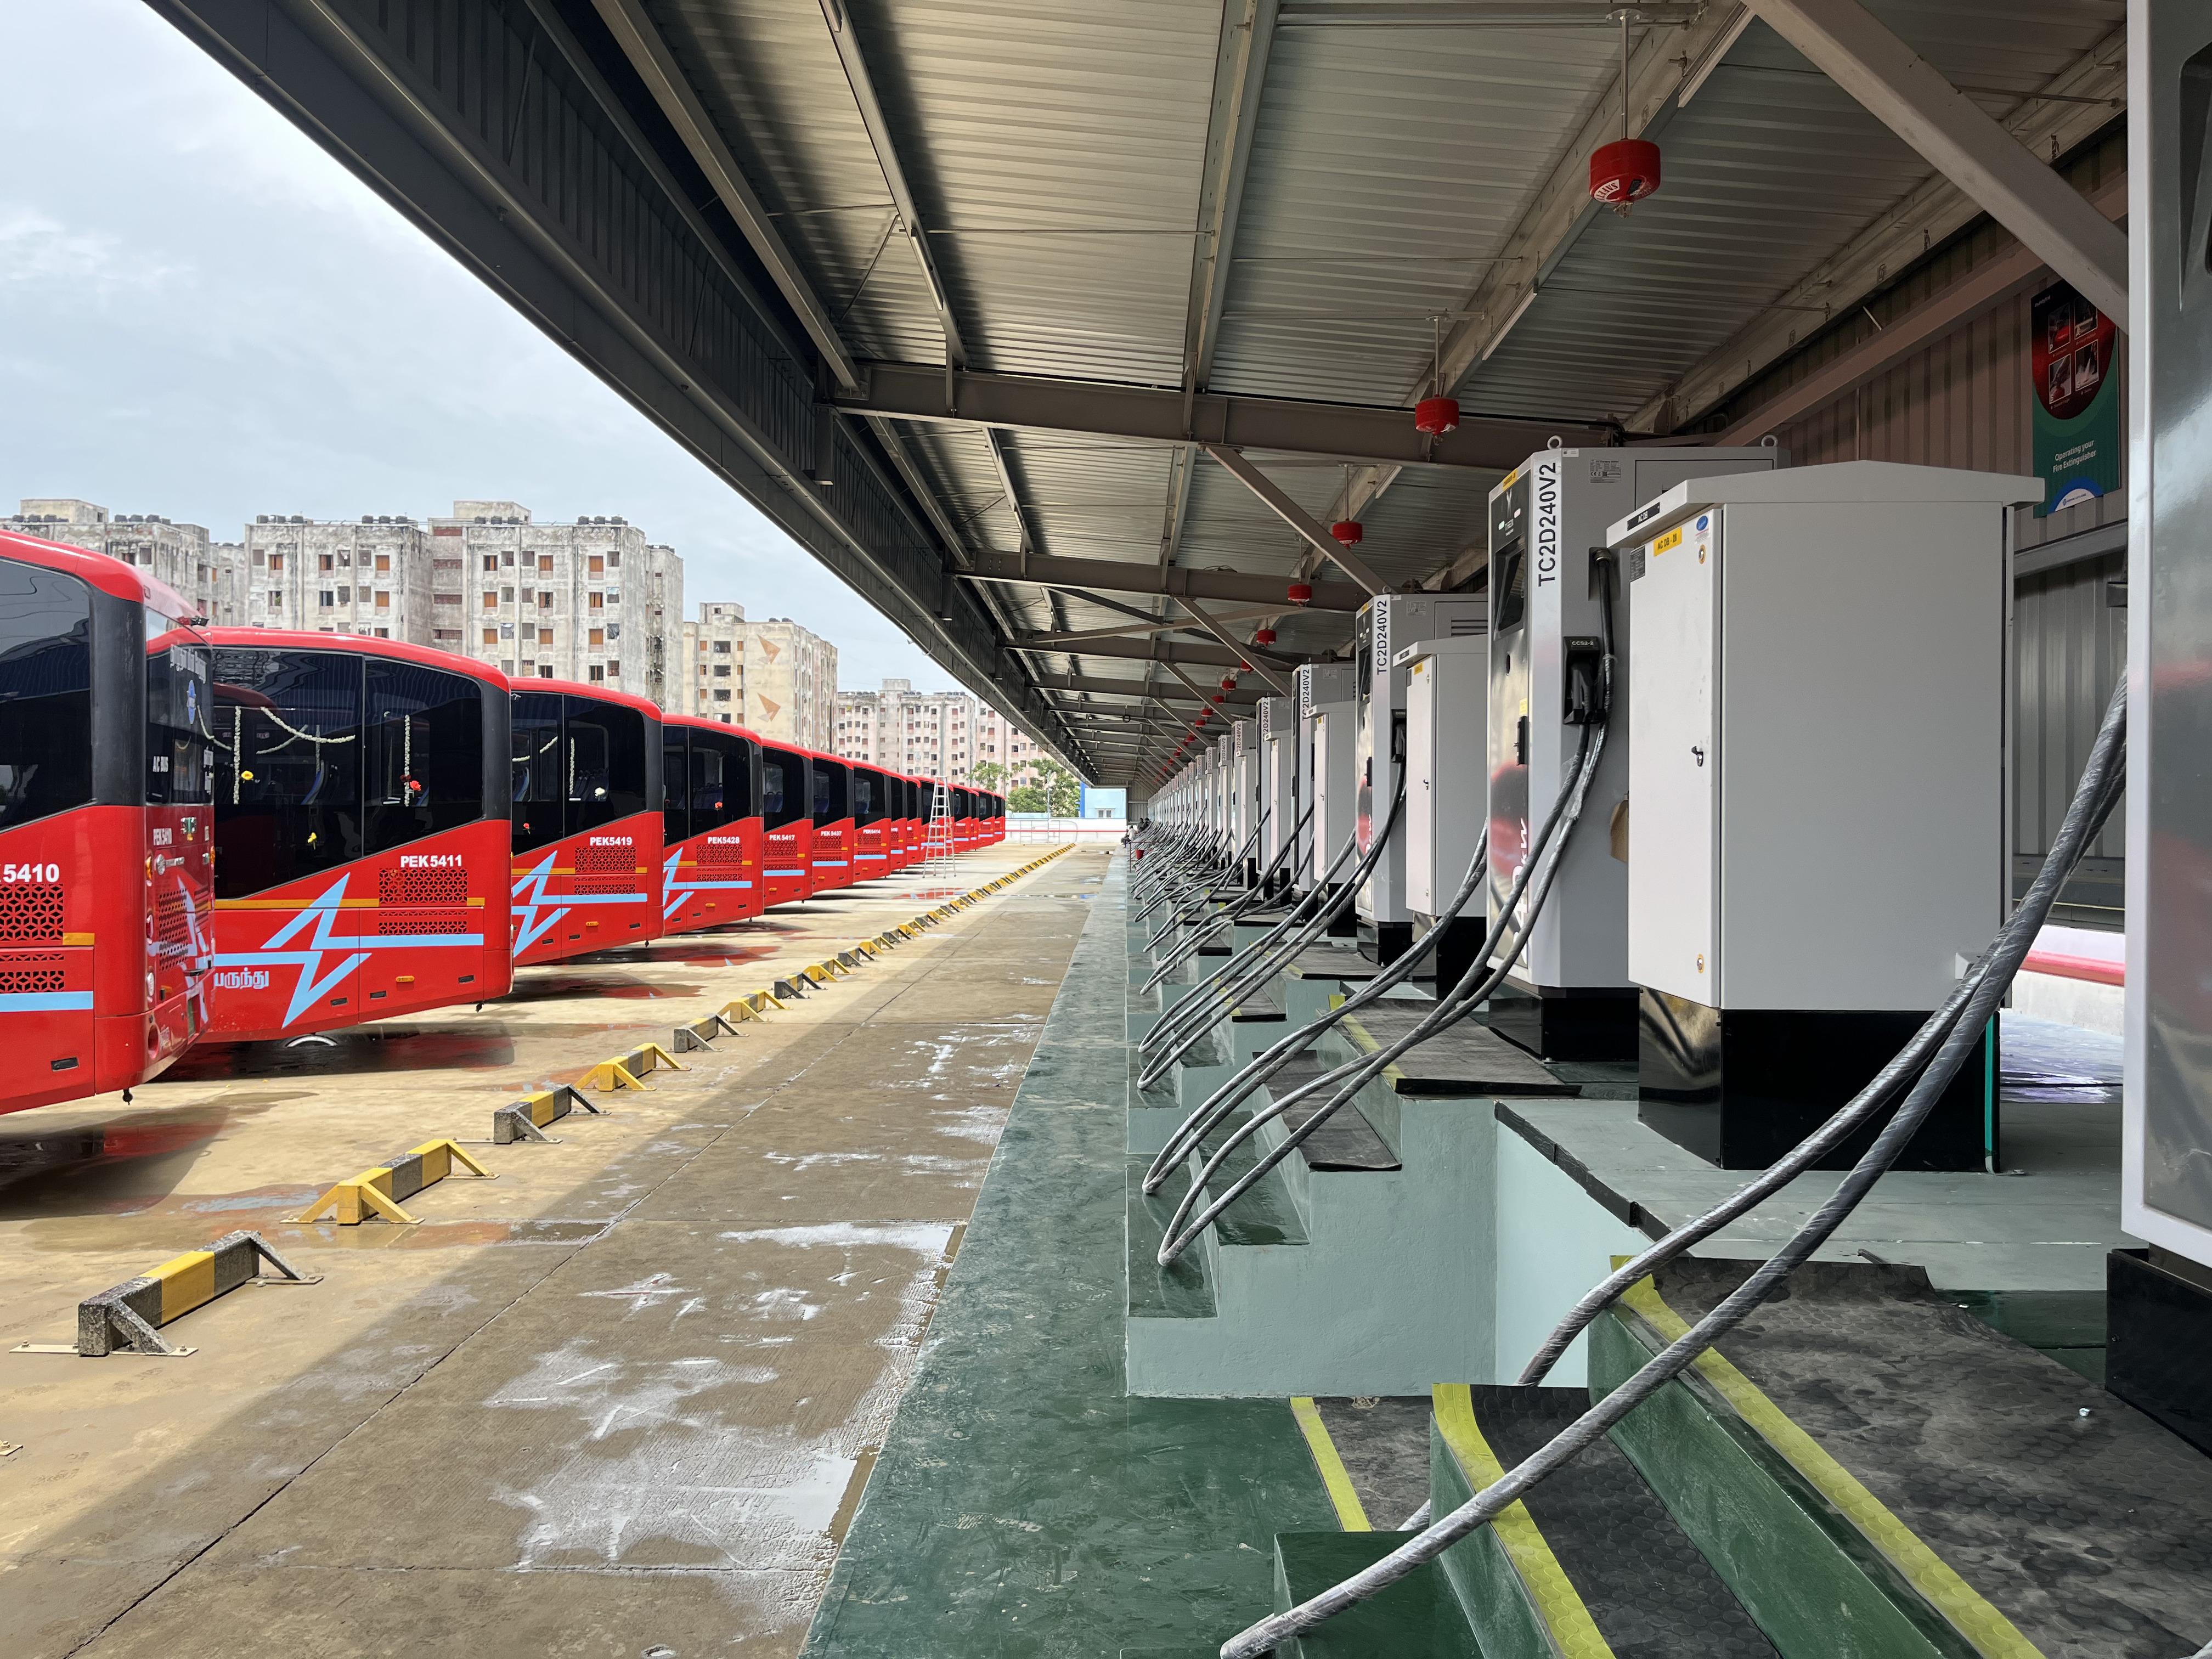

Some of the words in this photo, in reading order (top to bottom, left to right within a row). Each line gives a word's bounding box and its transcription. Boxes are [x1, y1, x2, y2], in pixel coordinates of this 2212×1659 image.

[2053, 465, 2062, 473] Fire
[2063, 450, 2096, 469] Extinguisher
[2055, 445, 2081, 461] Operating
[2082, 440, 2094, 452] your
[1538, 462, 1556, 586] TC2D240V2
[1377, 600, 1387, 675] TC2D240V2
[590, 837, 632, 846] PEK5419
[0, 864, 59, 883] 5410
